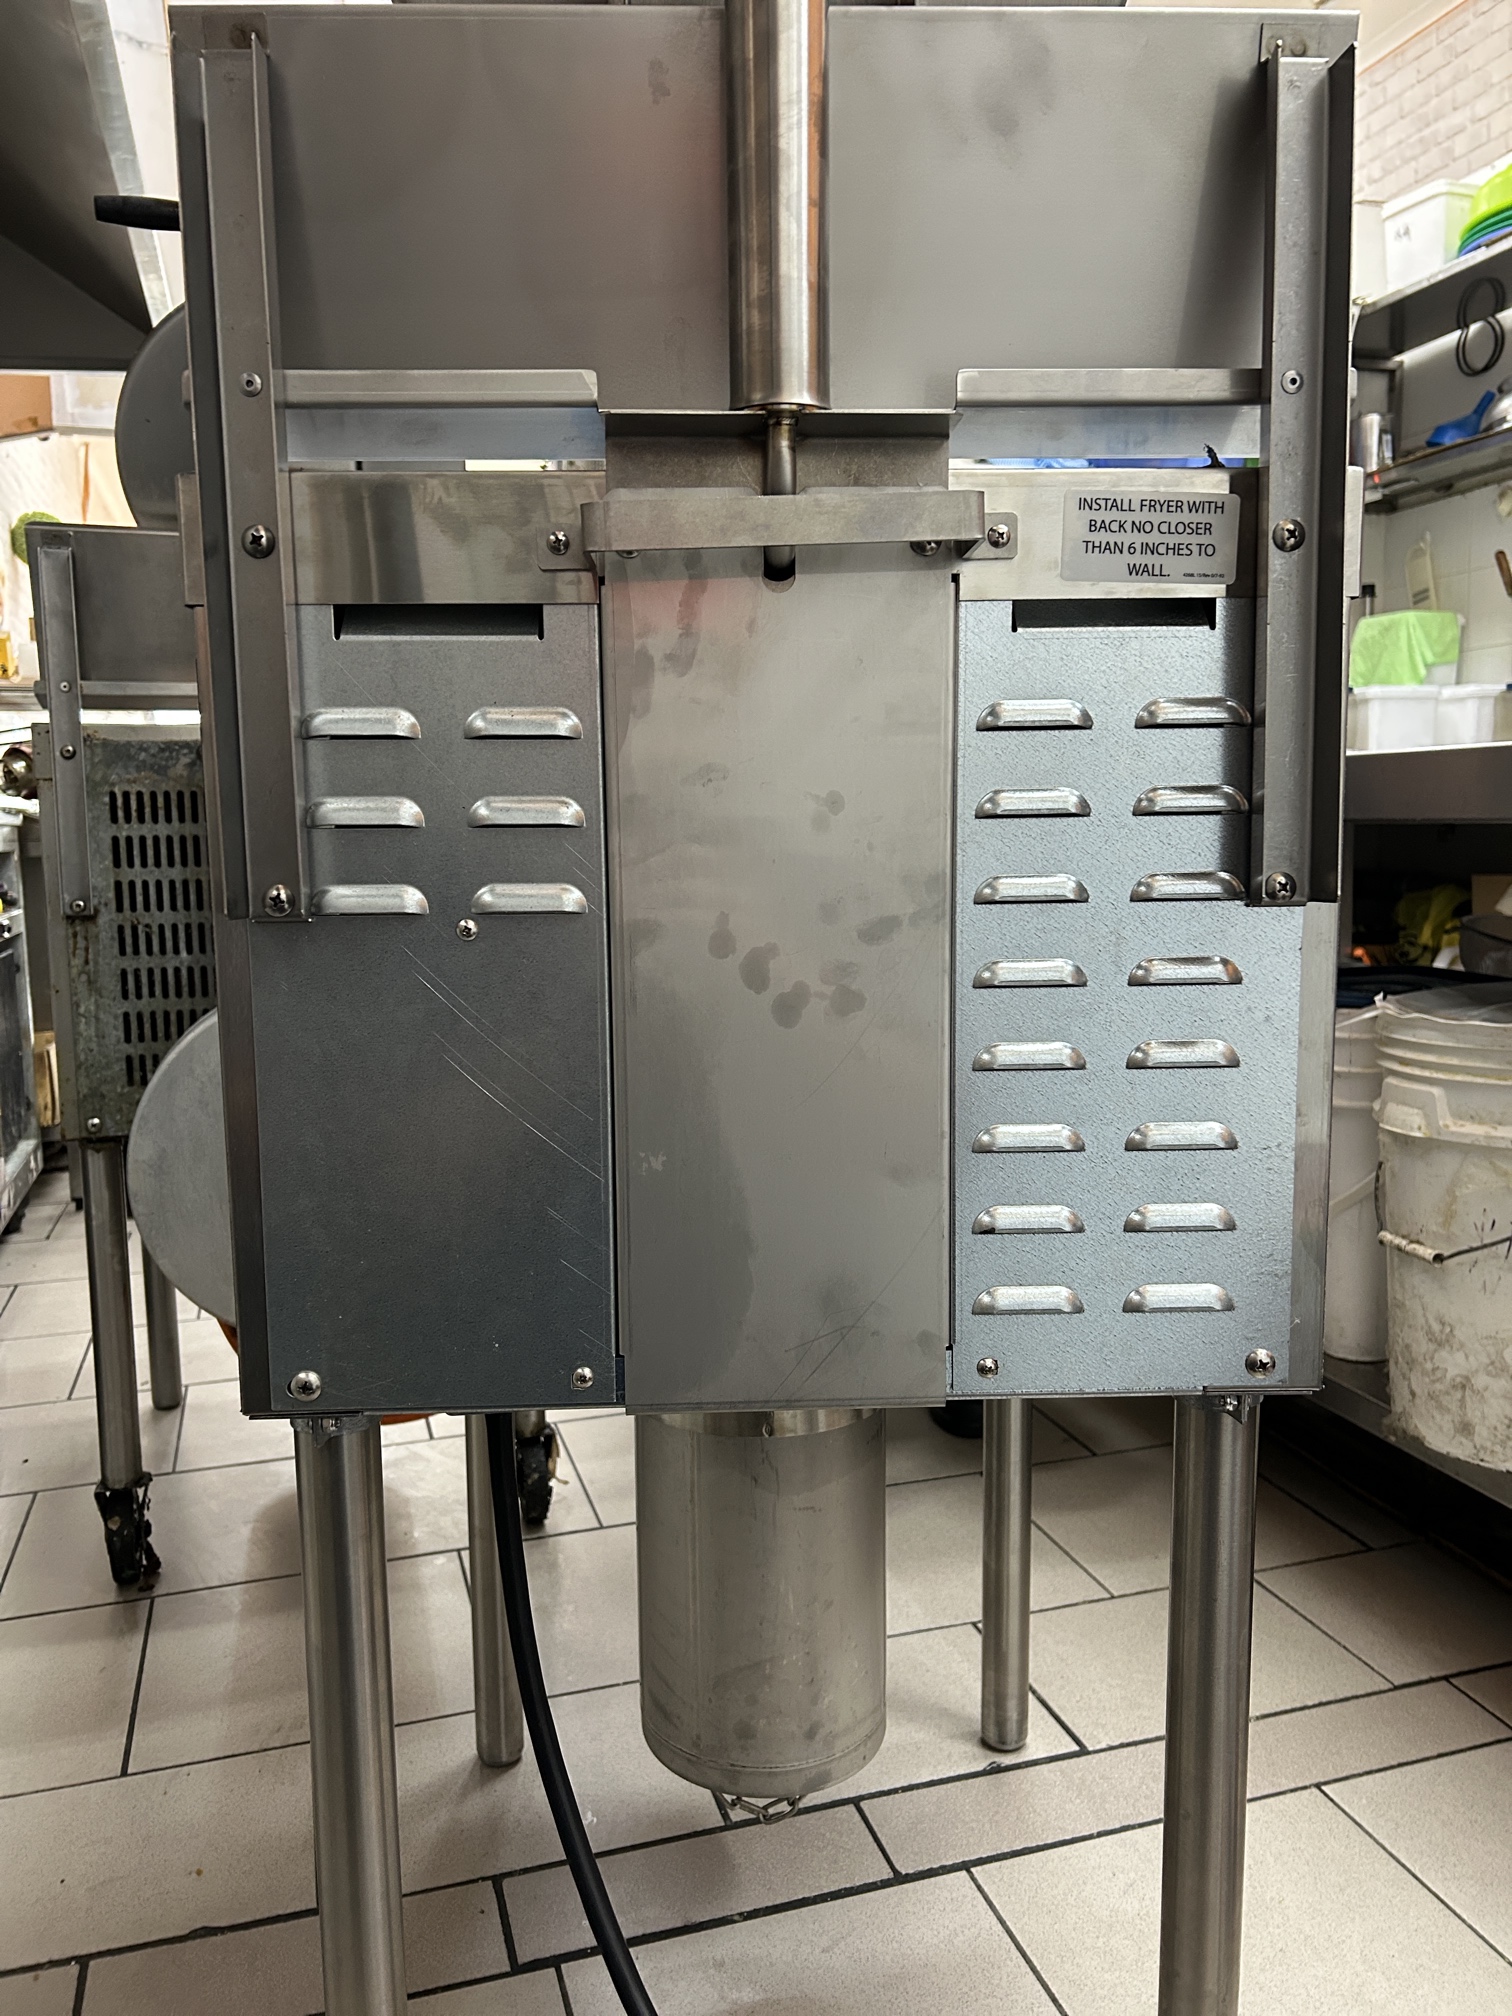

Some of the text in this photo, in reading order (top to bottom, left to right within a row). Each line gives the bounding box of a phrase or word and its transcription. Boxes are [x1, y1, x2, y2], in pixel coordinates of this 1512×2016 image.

[1078, 497, 1224, 514] INSTALL FRYER WITH
[1088, 519, 1212, 535] BACK NO CLOSER
[1082, 541, 1215, 557] THAN 6 INCHES TO
[1127, 563, 1170, 577] WALL.
